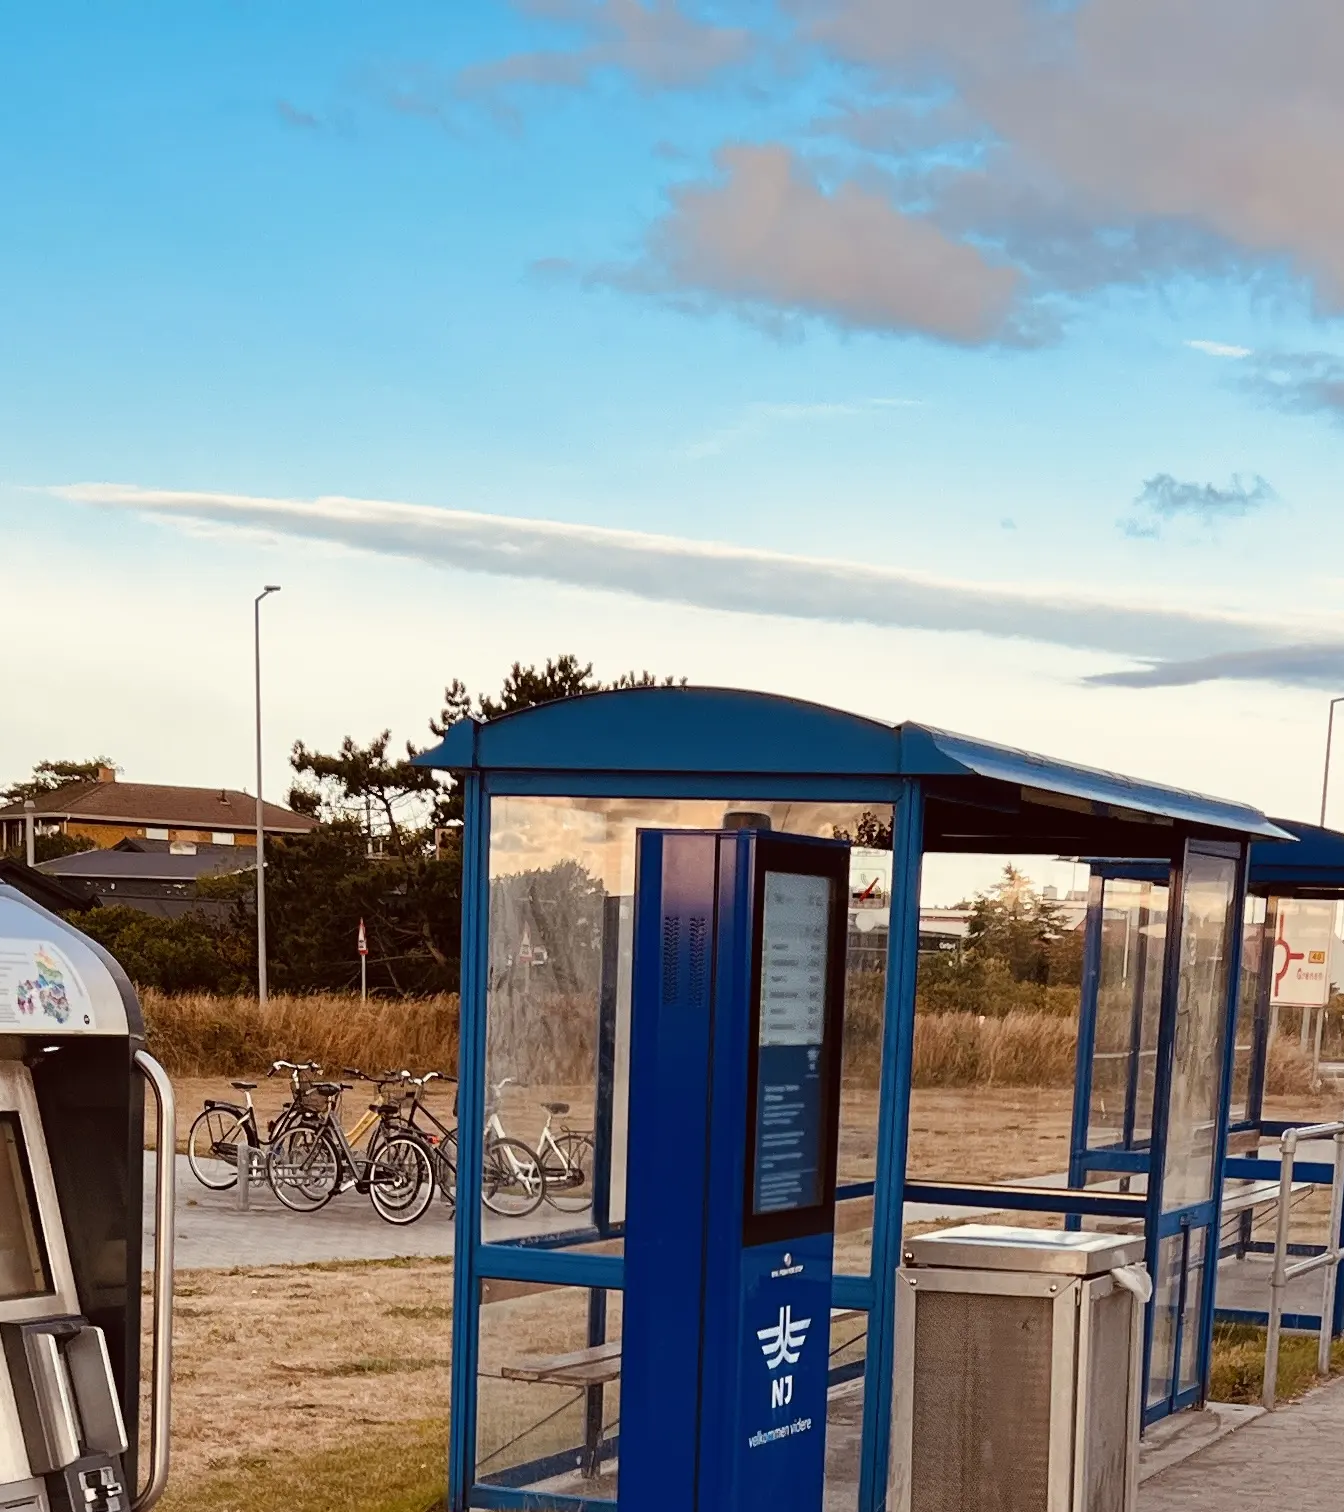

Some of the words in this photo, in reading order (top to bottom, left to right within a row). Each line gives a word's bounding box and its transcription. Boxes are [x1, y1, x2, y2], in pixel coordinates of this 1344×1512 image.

[771, 1375, 793, 1409] NJ
[748, 1425, 790, 1448] velkommen
[790, 1417, 812, 1434] videre
